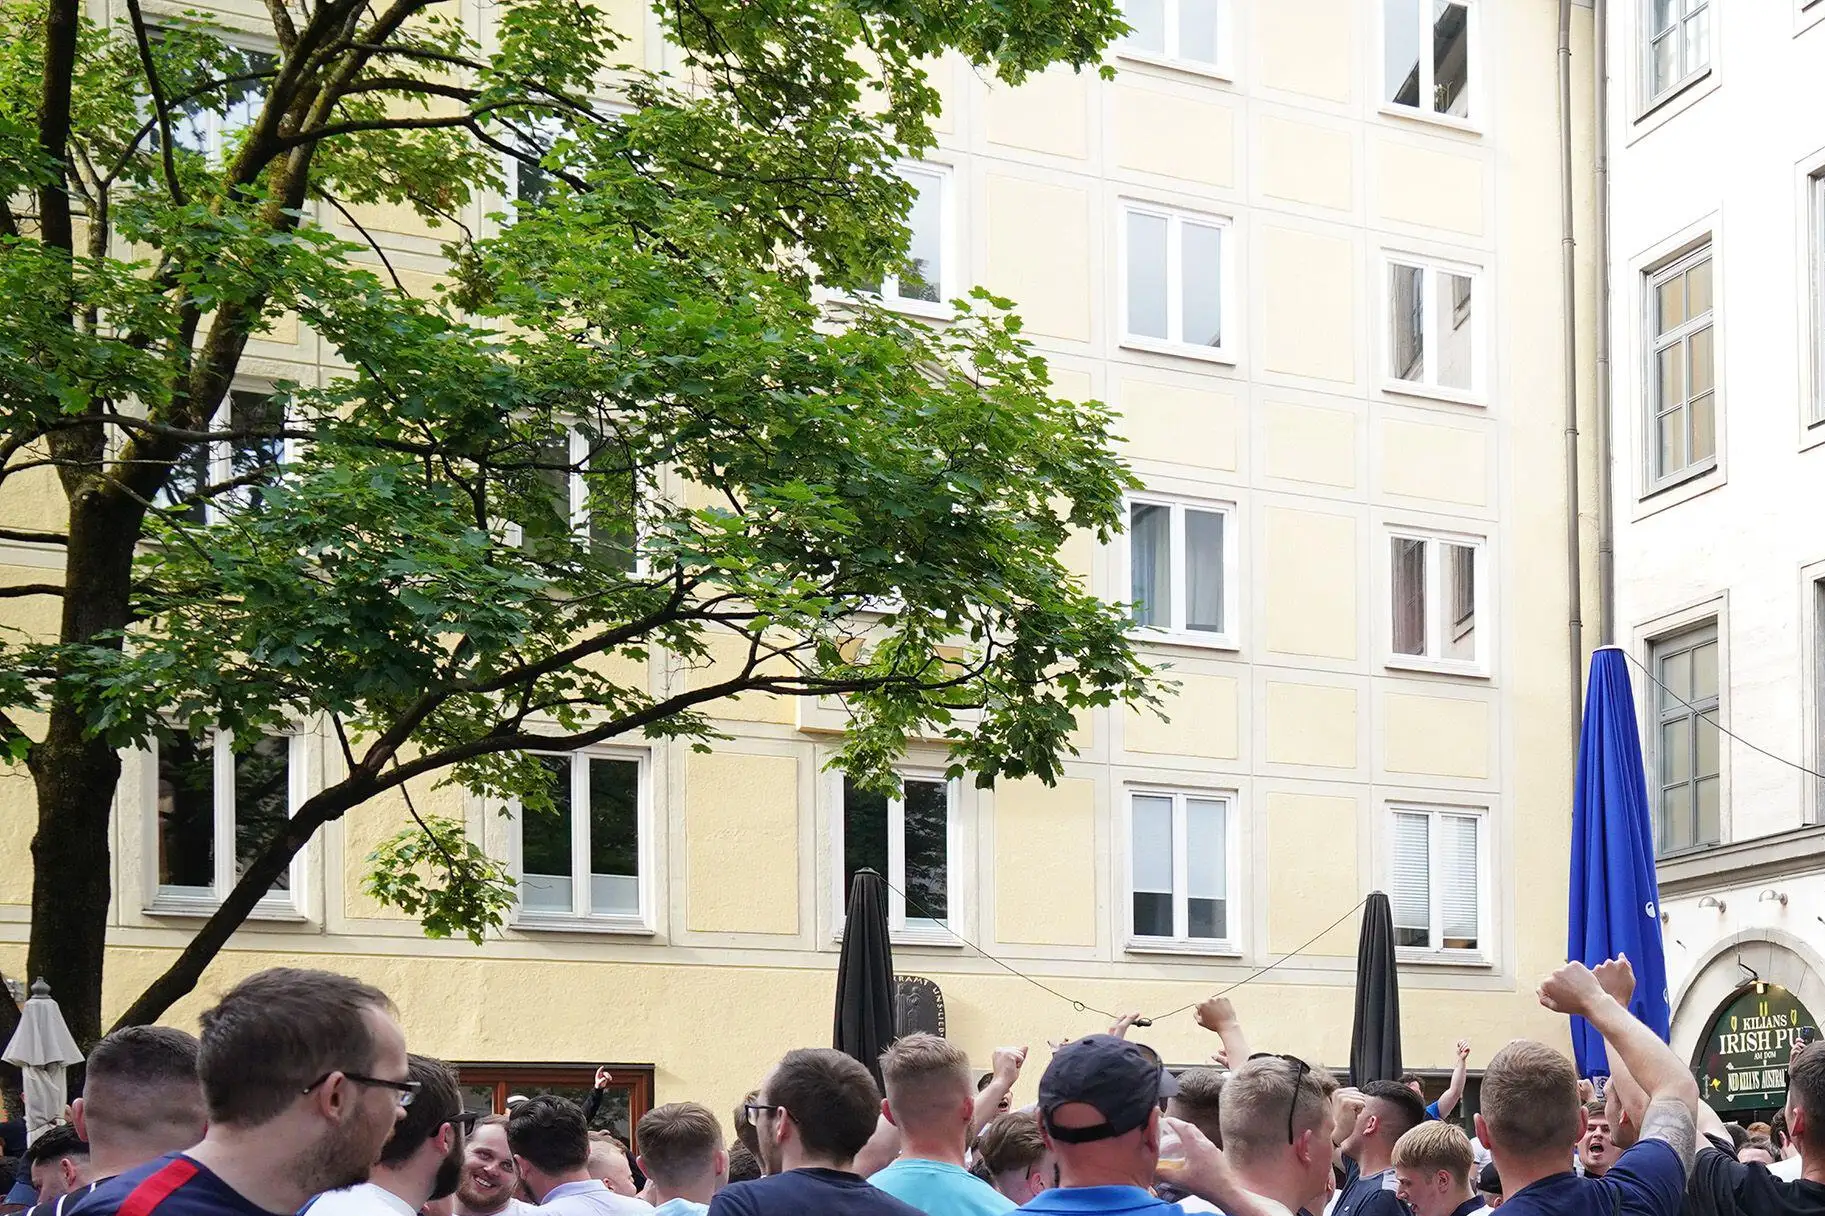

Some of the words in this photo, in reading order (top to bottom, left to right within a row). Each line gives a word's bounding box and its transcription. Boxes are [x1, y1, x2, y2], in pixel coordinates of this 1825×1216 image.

[1743, 1015, 1788, 1031] KILIANS
[1720, 1029, 1772, 1055] IRISH
[1774, 1026, 1801, 1050] PU
[1764, 1051, 1776, 1059] DOM
[1728, 1072, 1740, 1092] NED
[1761, 1068, 1788, 1089] AUSTRAL
